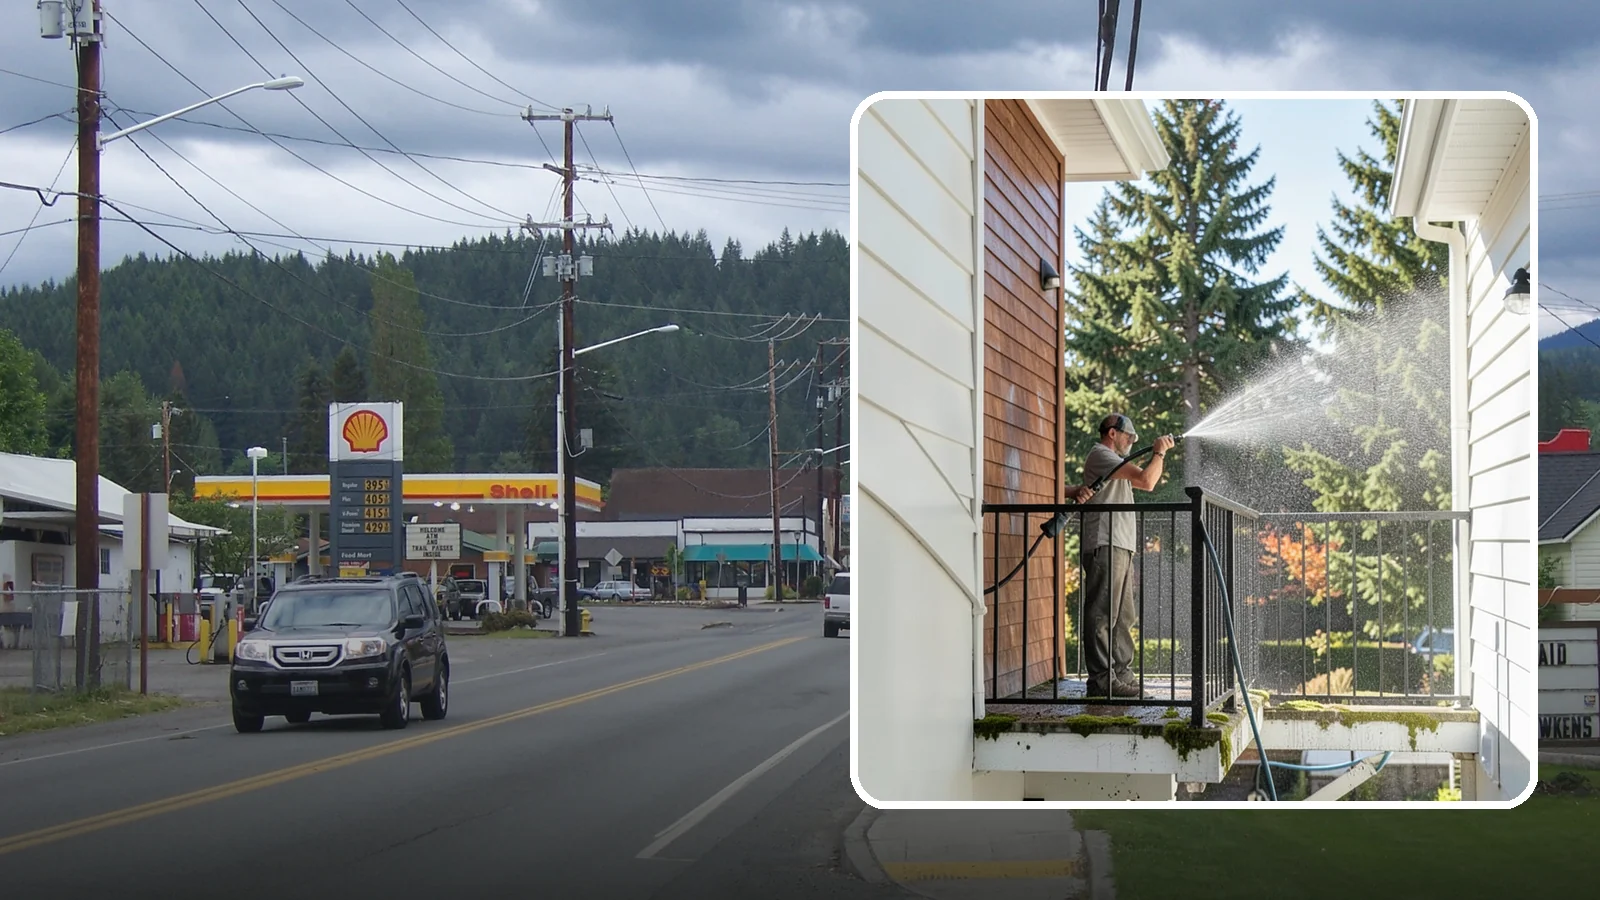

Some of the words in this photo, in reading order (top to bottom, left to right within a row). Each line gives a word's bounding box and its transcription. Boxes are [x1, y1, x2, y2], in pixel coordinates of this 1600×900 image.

[365, 480, 383, 490] 395
[490, 484, 547, 499] Shell
[365, 494, 383, 504] 405
[365, 508, 383, 518] 415
[365, 522, 383, 533] 429
